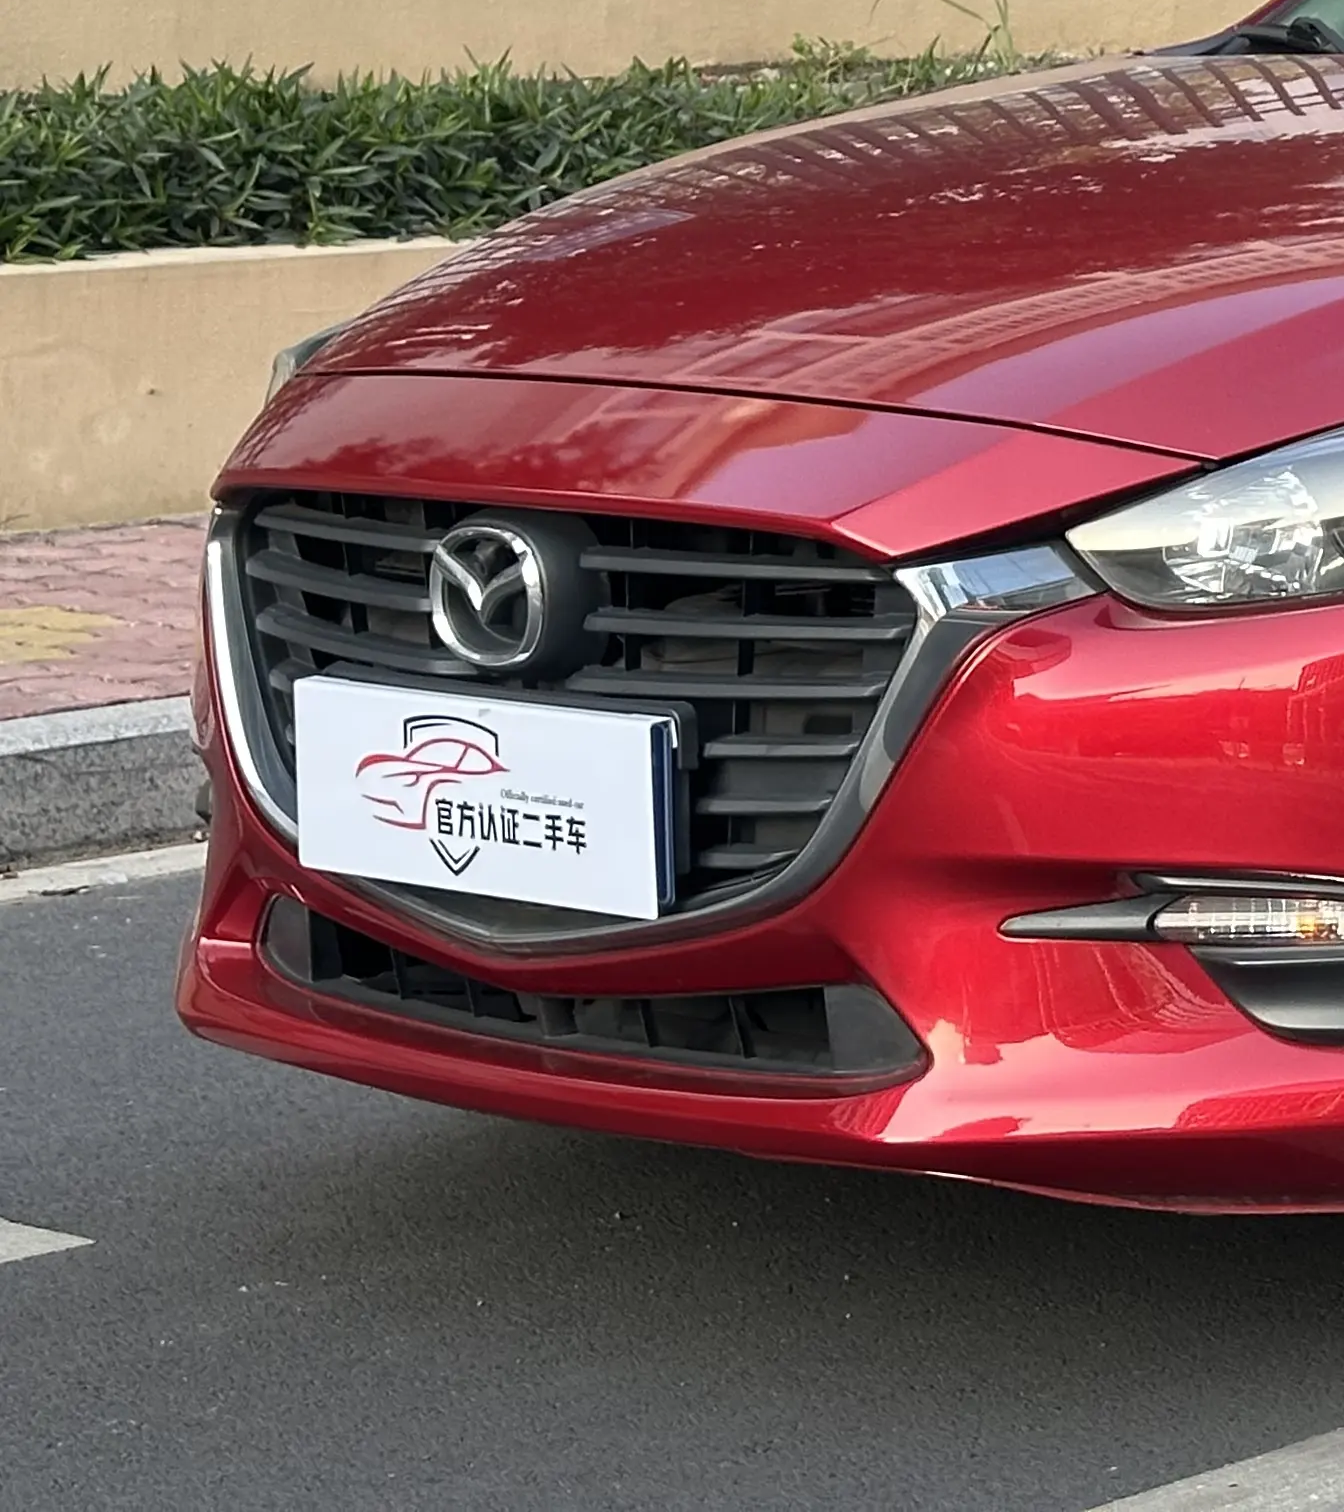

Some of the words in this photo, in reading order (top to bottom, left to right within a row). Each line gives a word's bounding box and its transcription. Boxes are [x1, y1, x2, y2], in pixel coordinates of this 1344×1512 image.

[435, 798, 587, 855] 官方认证二手车
